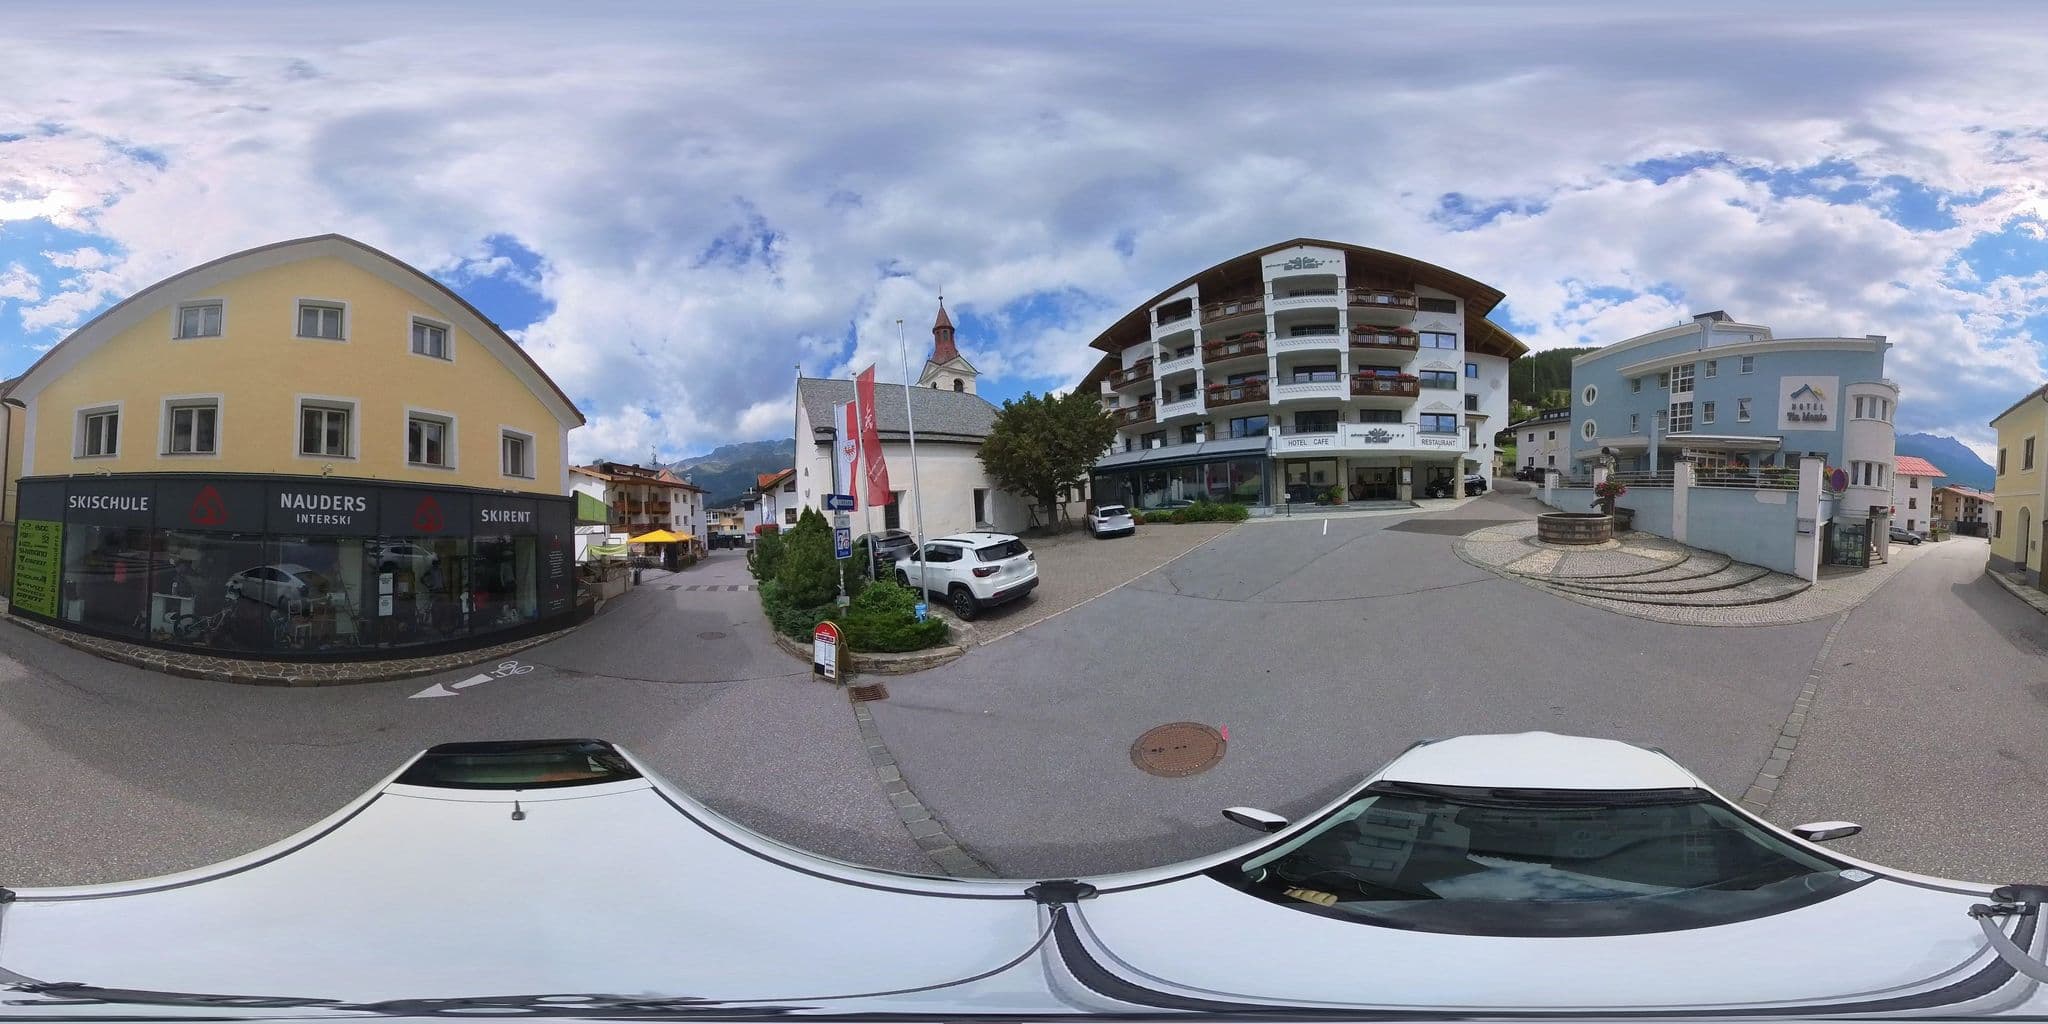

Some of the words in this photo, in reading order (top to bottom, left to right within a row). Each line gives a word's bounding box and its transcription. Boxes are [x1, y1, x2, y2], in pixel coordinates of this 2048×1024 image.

[1791, 403, 1824, 411] HOTEL
[1288, 439, 1308, 447] HOTEL
[1421, 438, 1456, 447] RESTAURANT
[69, 495, 149, 511] SKISCHULE
[280, 493, 367, 511] NAUDERS
[296, 513, 351, 525] INTERSKI
[481, 509, 531, 523] SKIRENT
